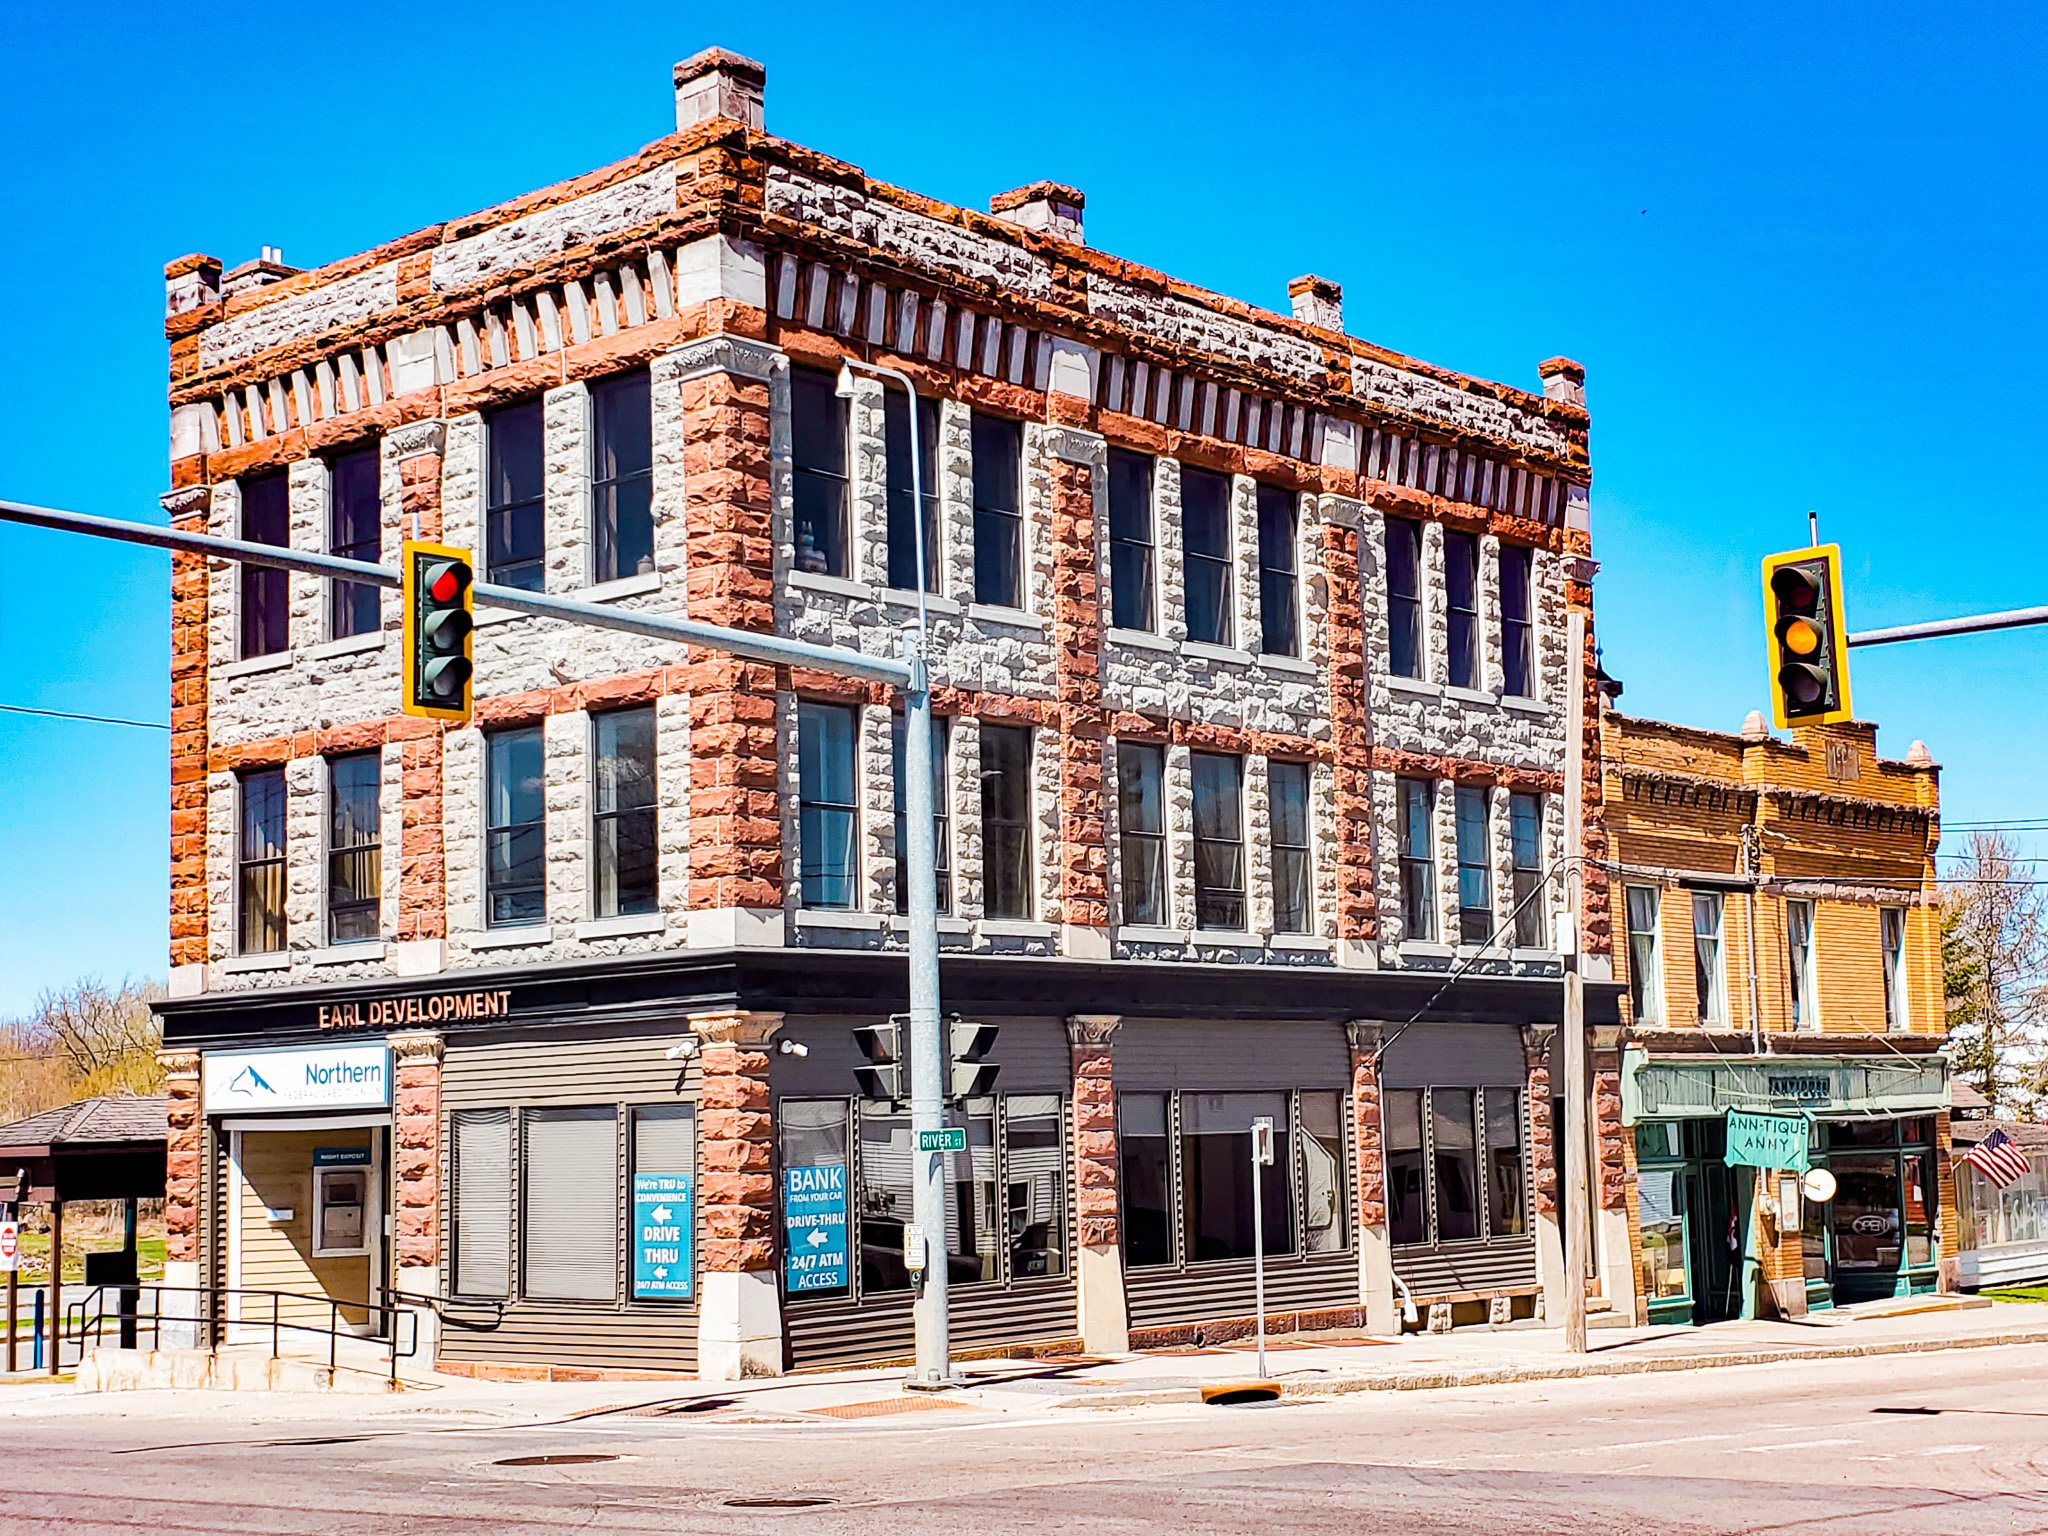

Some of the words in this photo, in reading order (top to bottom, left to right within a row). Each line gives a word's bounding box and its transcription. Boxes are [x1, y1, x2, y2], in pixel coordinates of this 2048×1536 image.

[319, 1003, 366, 1028] EARL
[369, 991, 511, 1024] DEVELOPMENT
[305, 1060, 381, 1085] Northern
[1729, 1117, 1806, 1135] ANN-TIQUE
[922, 1133, 951, 1148] RIVER
[636, 1178, 658, 1191] We're
[658, 1178, 676, 1190] TRU
[677, 1180, 687, 1190] to
[790, 1167, 843, 1193] BANK
[636, 1192, 687, 1203] CONVENIENCE
[790, 1193, 809, 1203] FROM
[810, 1192, 829, 1202] YOUR
[829, 1191, 843, 1200] CAR
[787, 1212, 845, 1228] DRIVE-THRU
[1855, 1219, 1886, 1232] OPEN
[643, 1226, 680, 1242] DRIVE
[644, 1248, 679, 1264] THRU
[791, 1254, 817, 1270] 24/7
[818, 1252, 844, 1268] ATM
[666, 1281, 688, 1290] ACCESS
[798, 1271, 838, 1289] ACCESS
